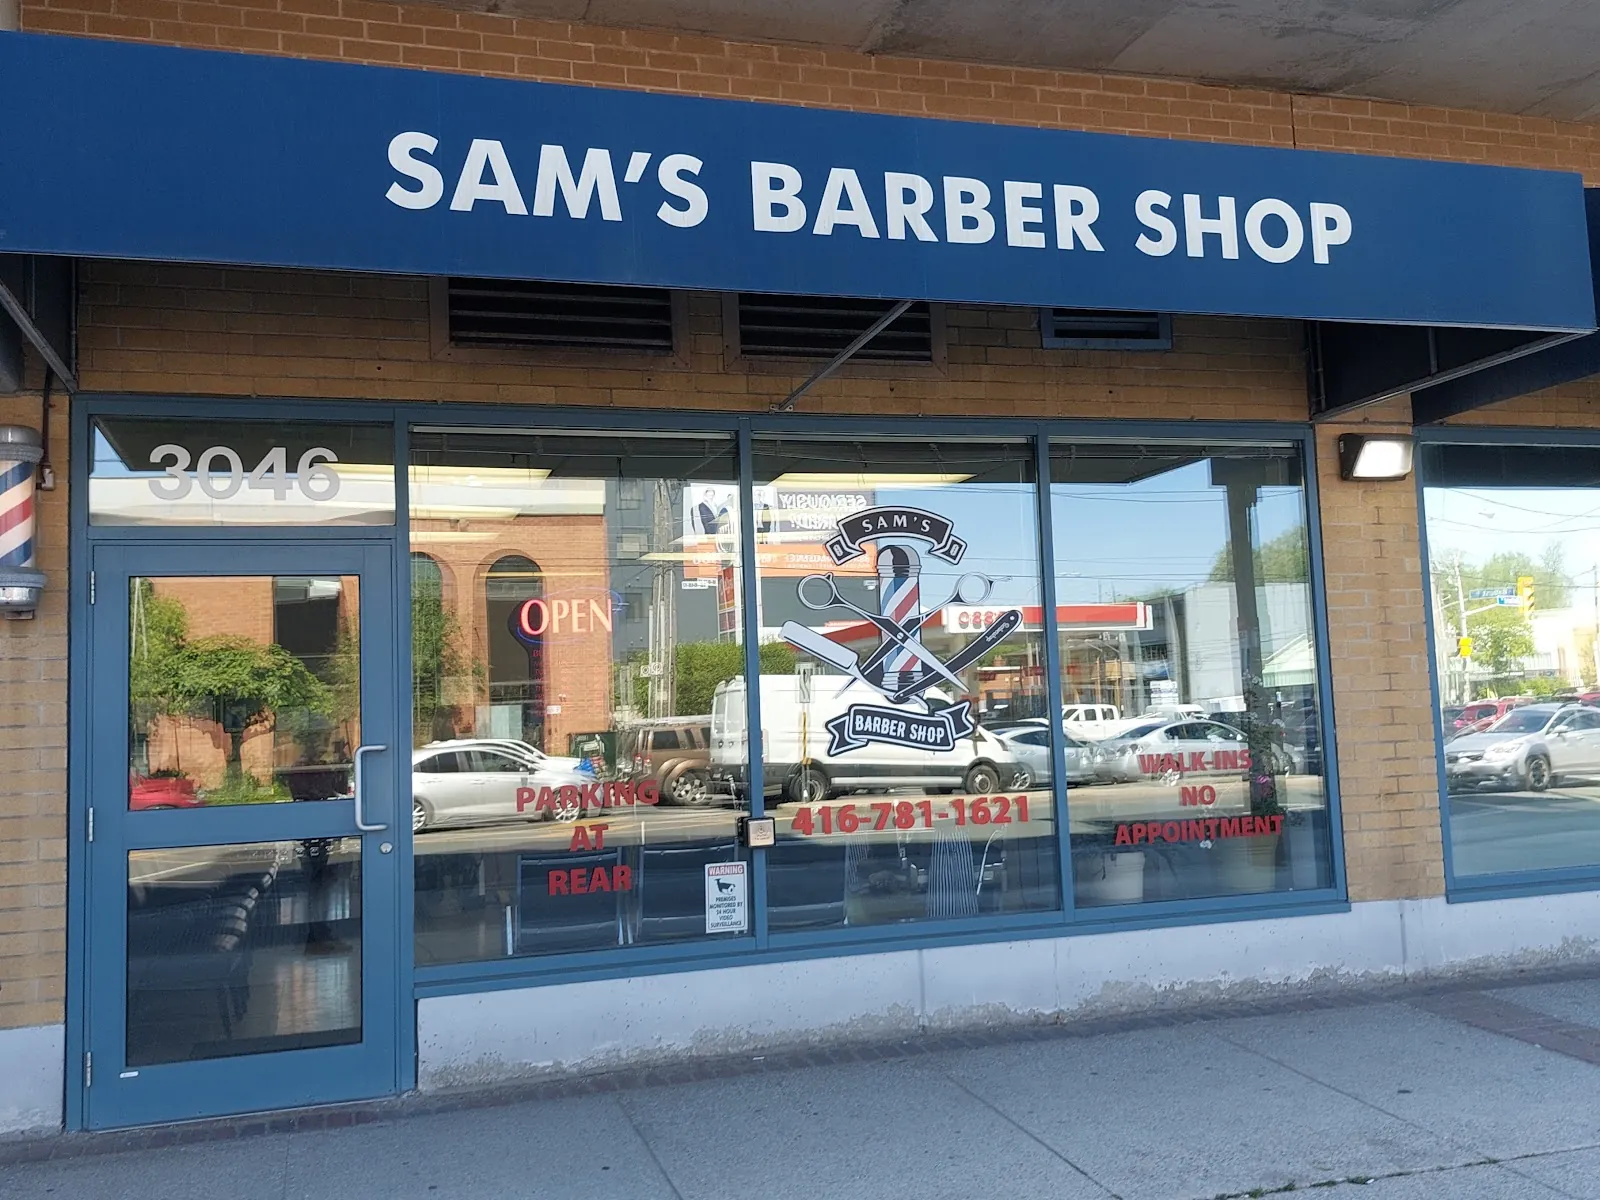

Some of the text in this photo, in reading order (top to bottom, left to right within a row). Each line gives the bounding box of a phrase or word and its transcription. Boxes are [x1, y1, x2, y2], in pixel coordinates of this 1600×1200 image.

[385, 131, 1352, 265] SAM'S BARBER SHOP
[148, 443, 341, 501] 3046
[861, 515, 931, 532] SAM'S
[520, 598, 613, 635] OPEN
[855, 715, 945, 743] BARBER SHOP
[1138, 749, 1253, 774] WALK-INS
[516, 779, 660, 812] PARKING
[1179, 785, 1216, 806] NO
[791, 795, 1029, 835] 416-781-1621
[1115, 814, 1285, 846] APPOINTMENT
[569, 824, 609, 851] AT
[548, 865, 633, 896] REAR
[709, 865, 743, 876] WARNING
